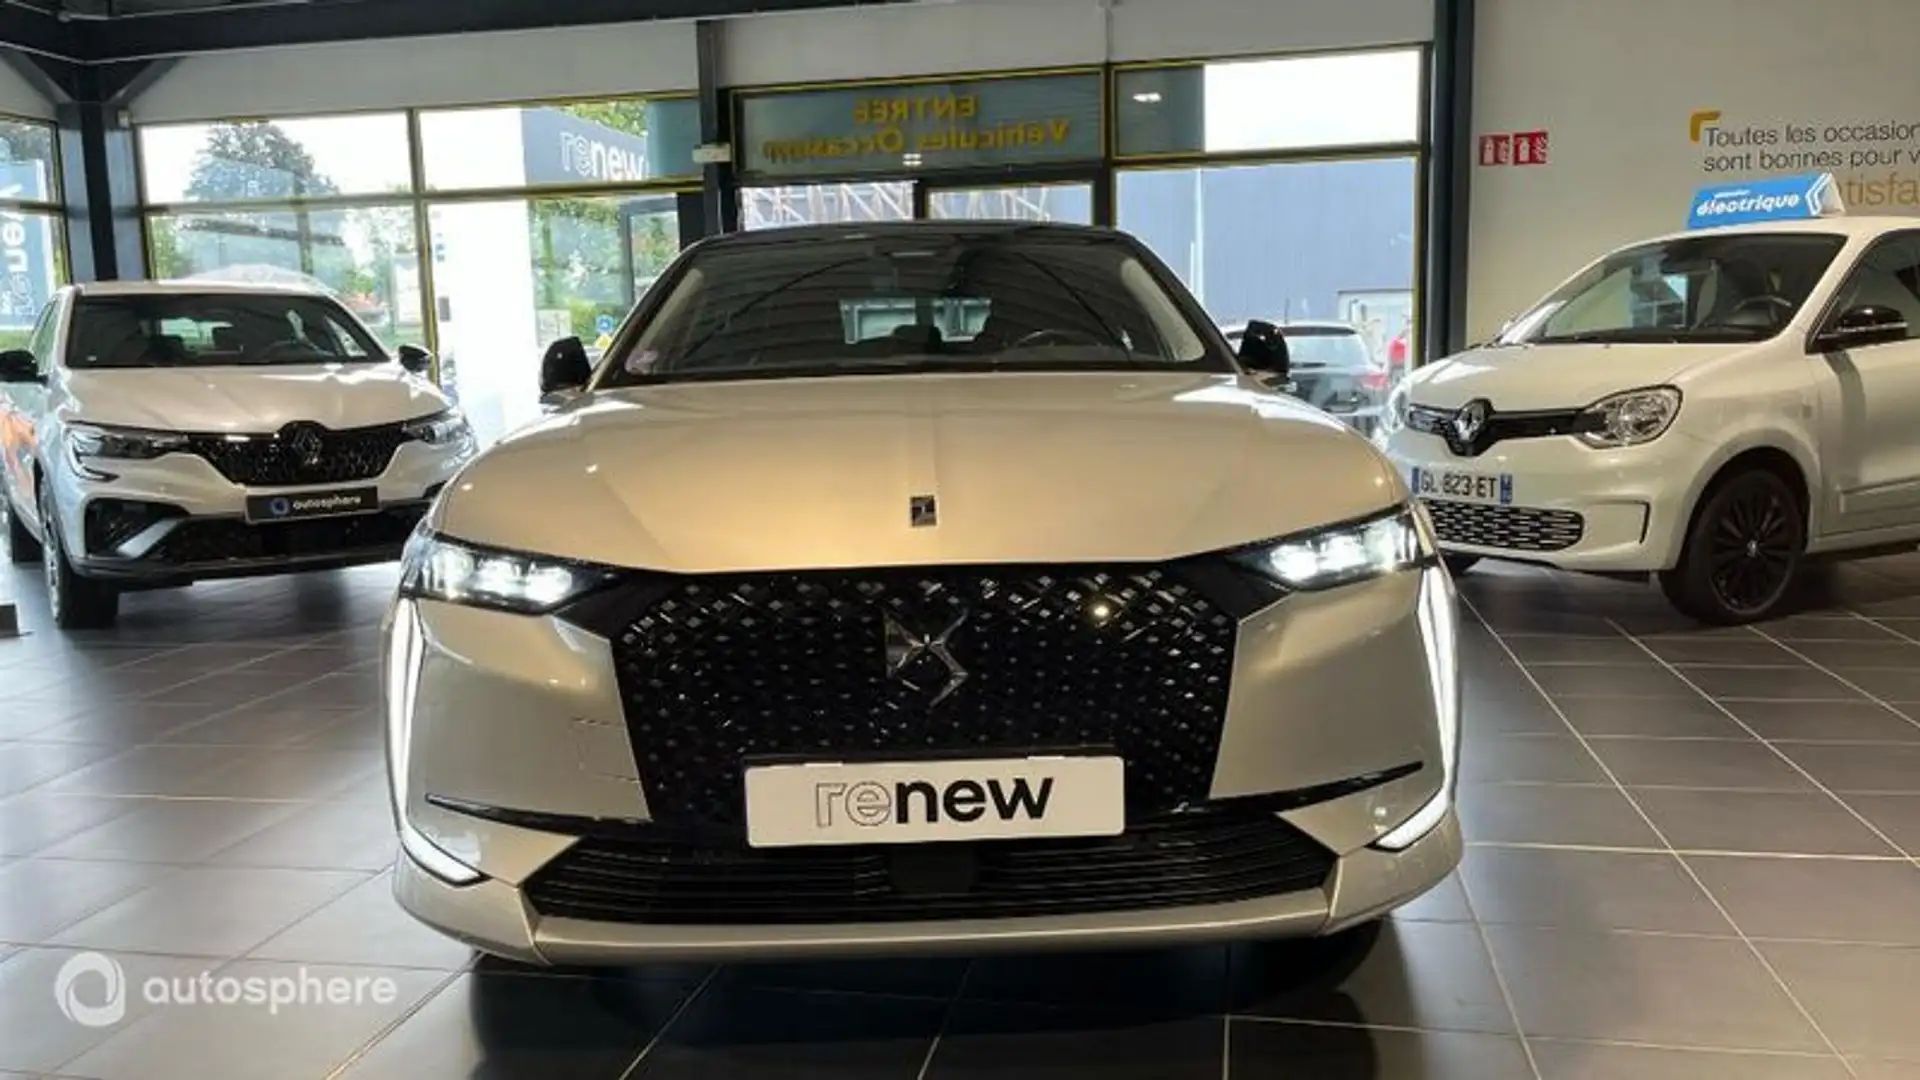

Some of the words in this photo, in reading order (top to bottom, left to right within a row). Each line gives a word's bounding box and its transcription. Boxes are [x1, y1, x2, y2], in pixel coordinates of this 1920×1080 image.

[1705, 126, 1779, 148] Toutes
[1786, 123, 1816, 144] les
[560, 132, 650, 180] renew
[1703, 151, 1752, 172] sont
[1759, 148, 1843, 170] bonnes
[1850, 148, 1902, 169] pour
[815, 777, 1054, 828] renew
